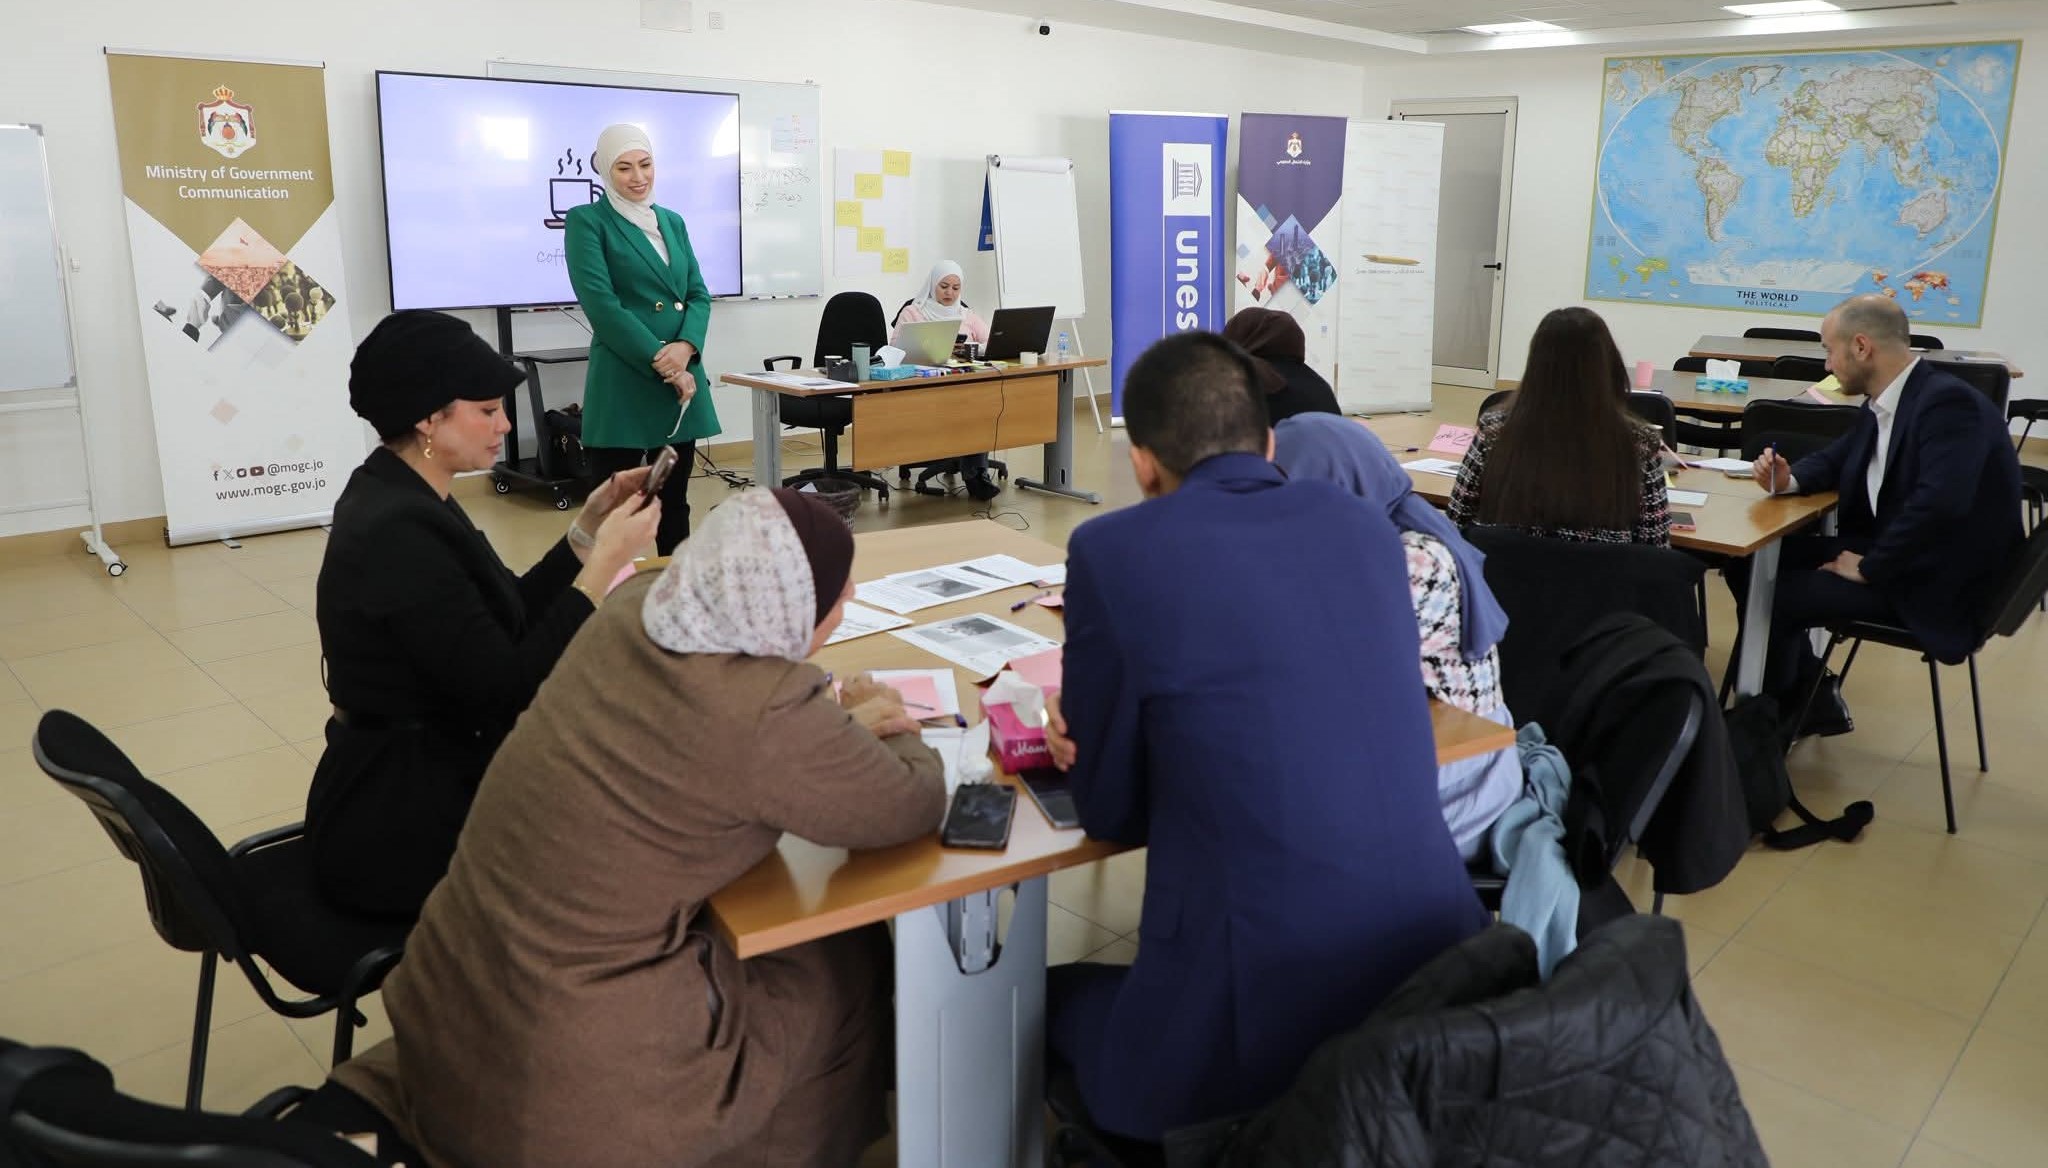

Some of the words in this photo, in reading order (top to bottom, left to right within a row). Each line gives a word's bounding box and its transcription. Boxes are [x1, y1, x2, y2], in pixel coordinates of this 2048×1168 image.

[145, 165, 207, 183] Ministry
[211, 166, 226, 180] of
[229, 166, 315, 181] Government
[178, 185, 289, 199] Communication
[1737, 290, 1757, 299] THE
[1761, 292, 1799, 302] WORLD
[1745, 300, 1789, 308] POLITICAL
[267, 459, 324, 476] @mogc.jo
[216, 478, 326, 500] www.mogc.gov.jo
